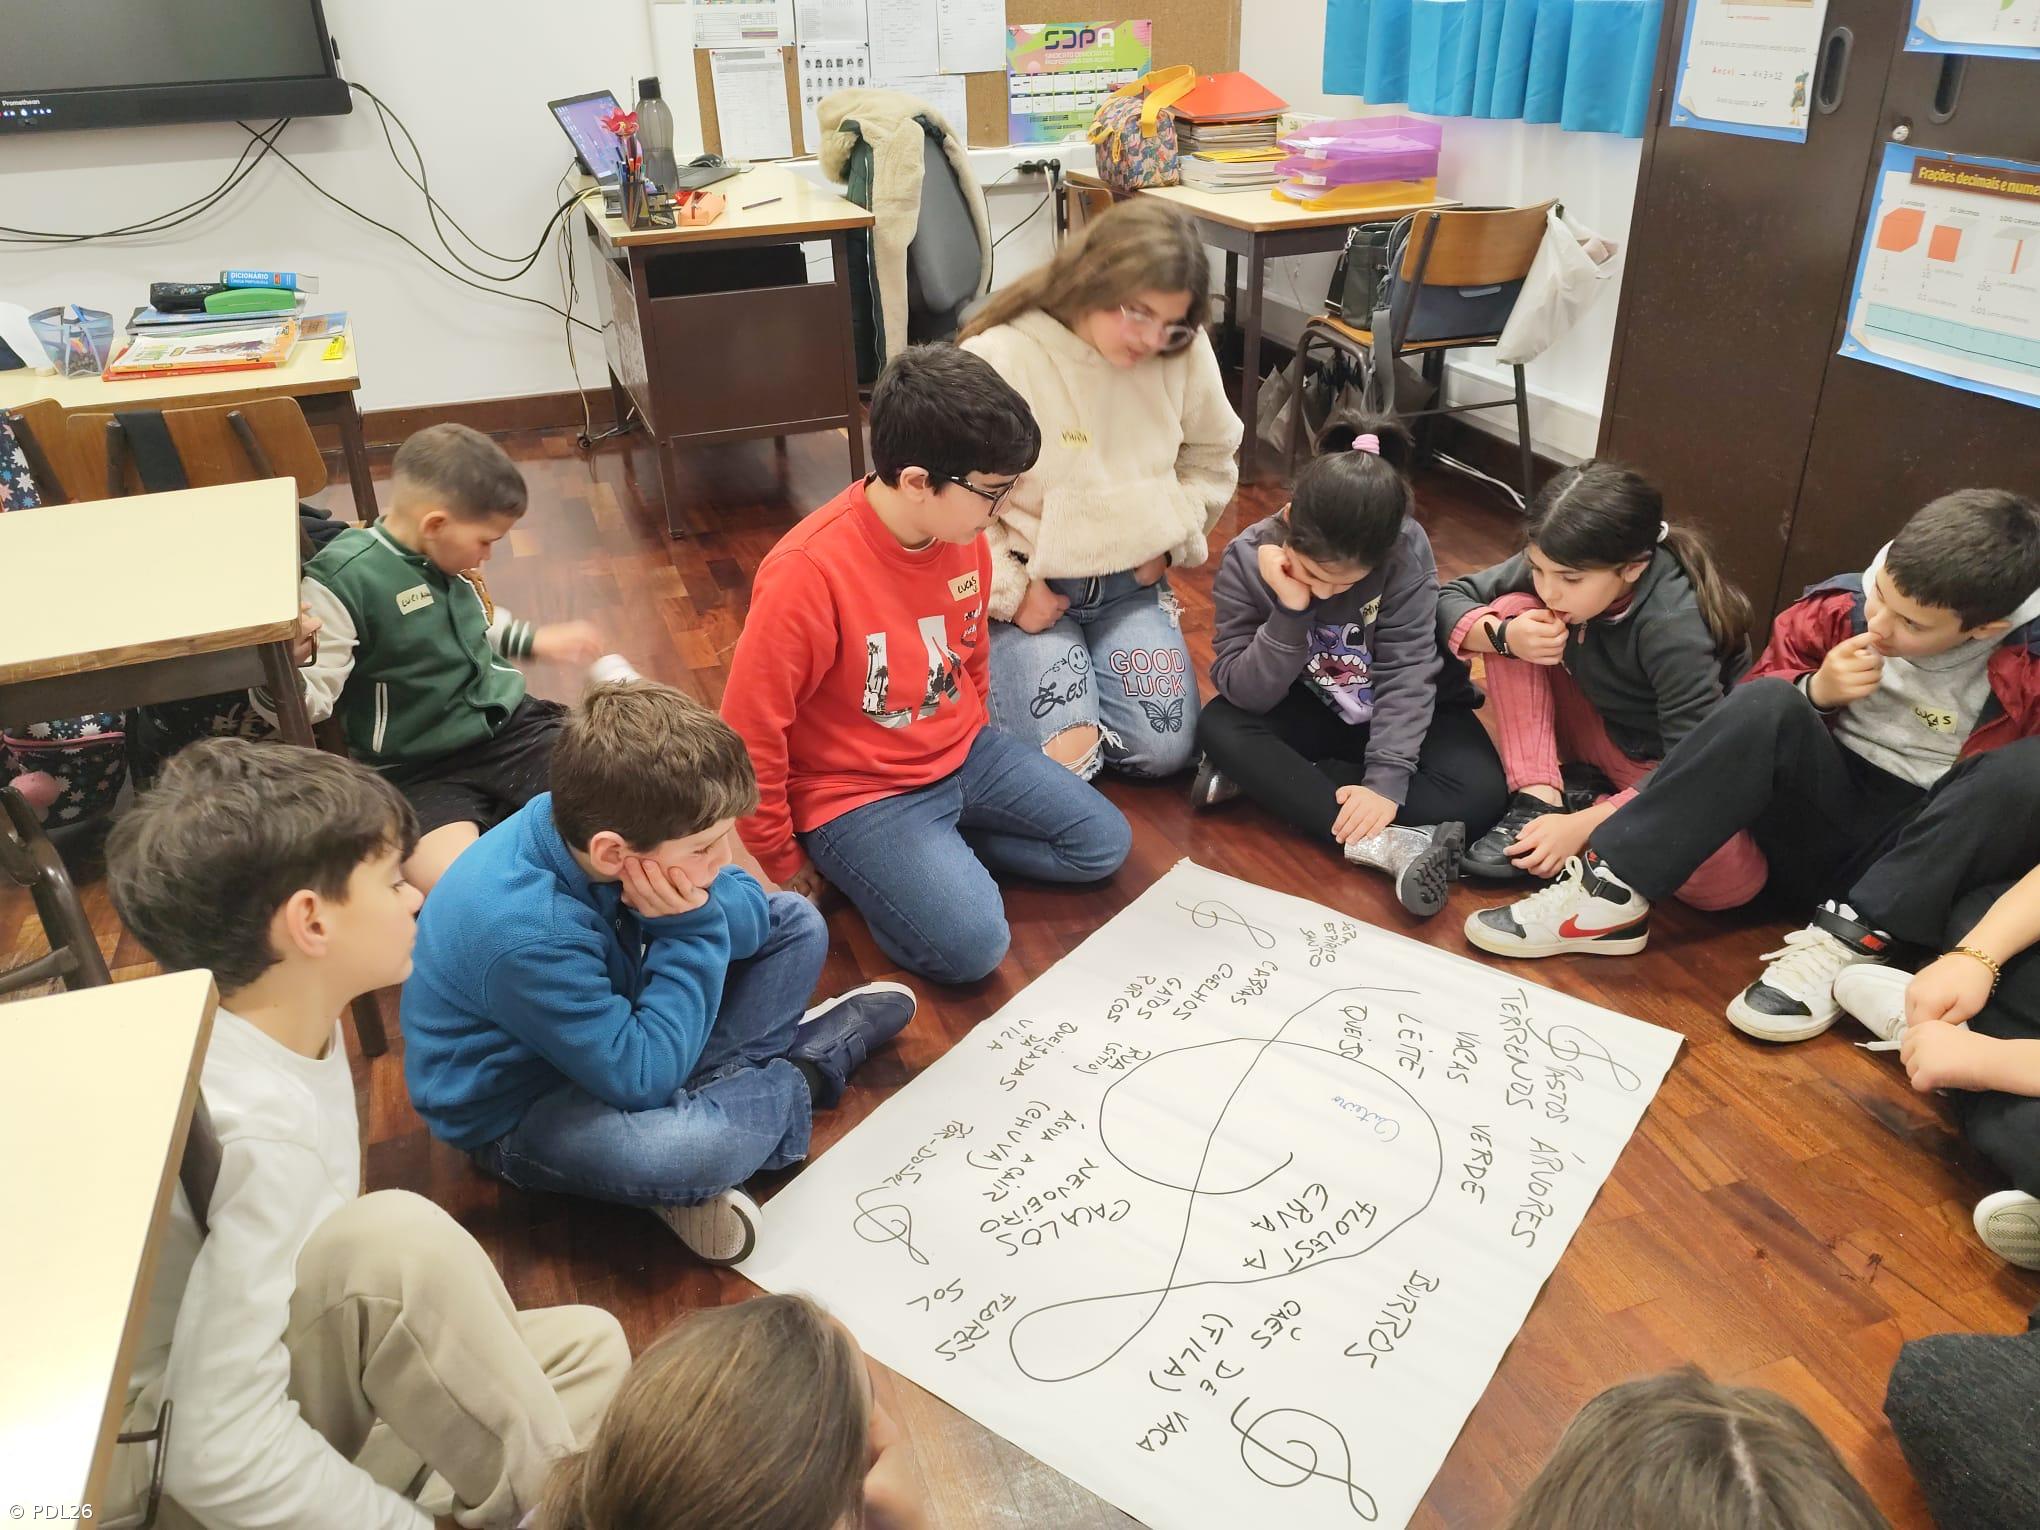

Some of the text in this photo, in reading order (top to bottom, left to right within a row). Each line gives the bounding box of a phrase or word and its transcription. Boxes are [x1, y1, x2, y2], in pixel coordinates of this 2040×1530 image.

[1919, 166, 1956, 184] Frações
[1956, 172, 2001, 190] decimais
[2000, 181, 2008, 192] e
[957, 575, 978, 594] LUCAS
[1109, 648, 1186, 675] GOOD
[1122, 674, 1187, 698] LUCK
[1107, 975, 1157, 1023] PORCOS
[1137, 977, 1182, 1020] GATOS
[1230, 960, 1279, 1006] CABRAS
[1000, 1022, 1078, 1092] QUEIJADAS
[1020, 1034, 1045, 1048] DA
[1108, 1047, 1152, 1071] RUA
[1447, 1031, 1482, 1084] VACAS
[1499, 988, 1534, 1110] TERRENOS
[1544, 1064, 1584, 1124] PASTOS
[966, 1100, 1051, 1170] (CHUVA)
[1040, 1110, 1085, 1142] ÁGUA
[1331, 1095, 1401, 1142] Outeiro
[1461, 1124, 1493, 1205] VERDE
[980, 1157, 1099, 1233] NEVOEIRO
[1250, 1183, 1329, 1232] ERVA
[1511, 1136, 1586, 1248] ÁRVORES
[906, 1278, 964, 1312] SOL
[934, 1292, 1017, 1362] FLORES
[1343, 1269, 1439, 1369] BURROS
[1149, 1313, 1234, 1392] (FILA)
[1199, 1359, 1245, 1397] DE
[1135, 1411, 1190, 1452] VACA
